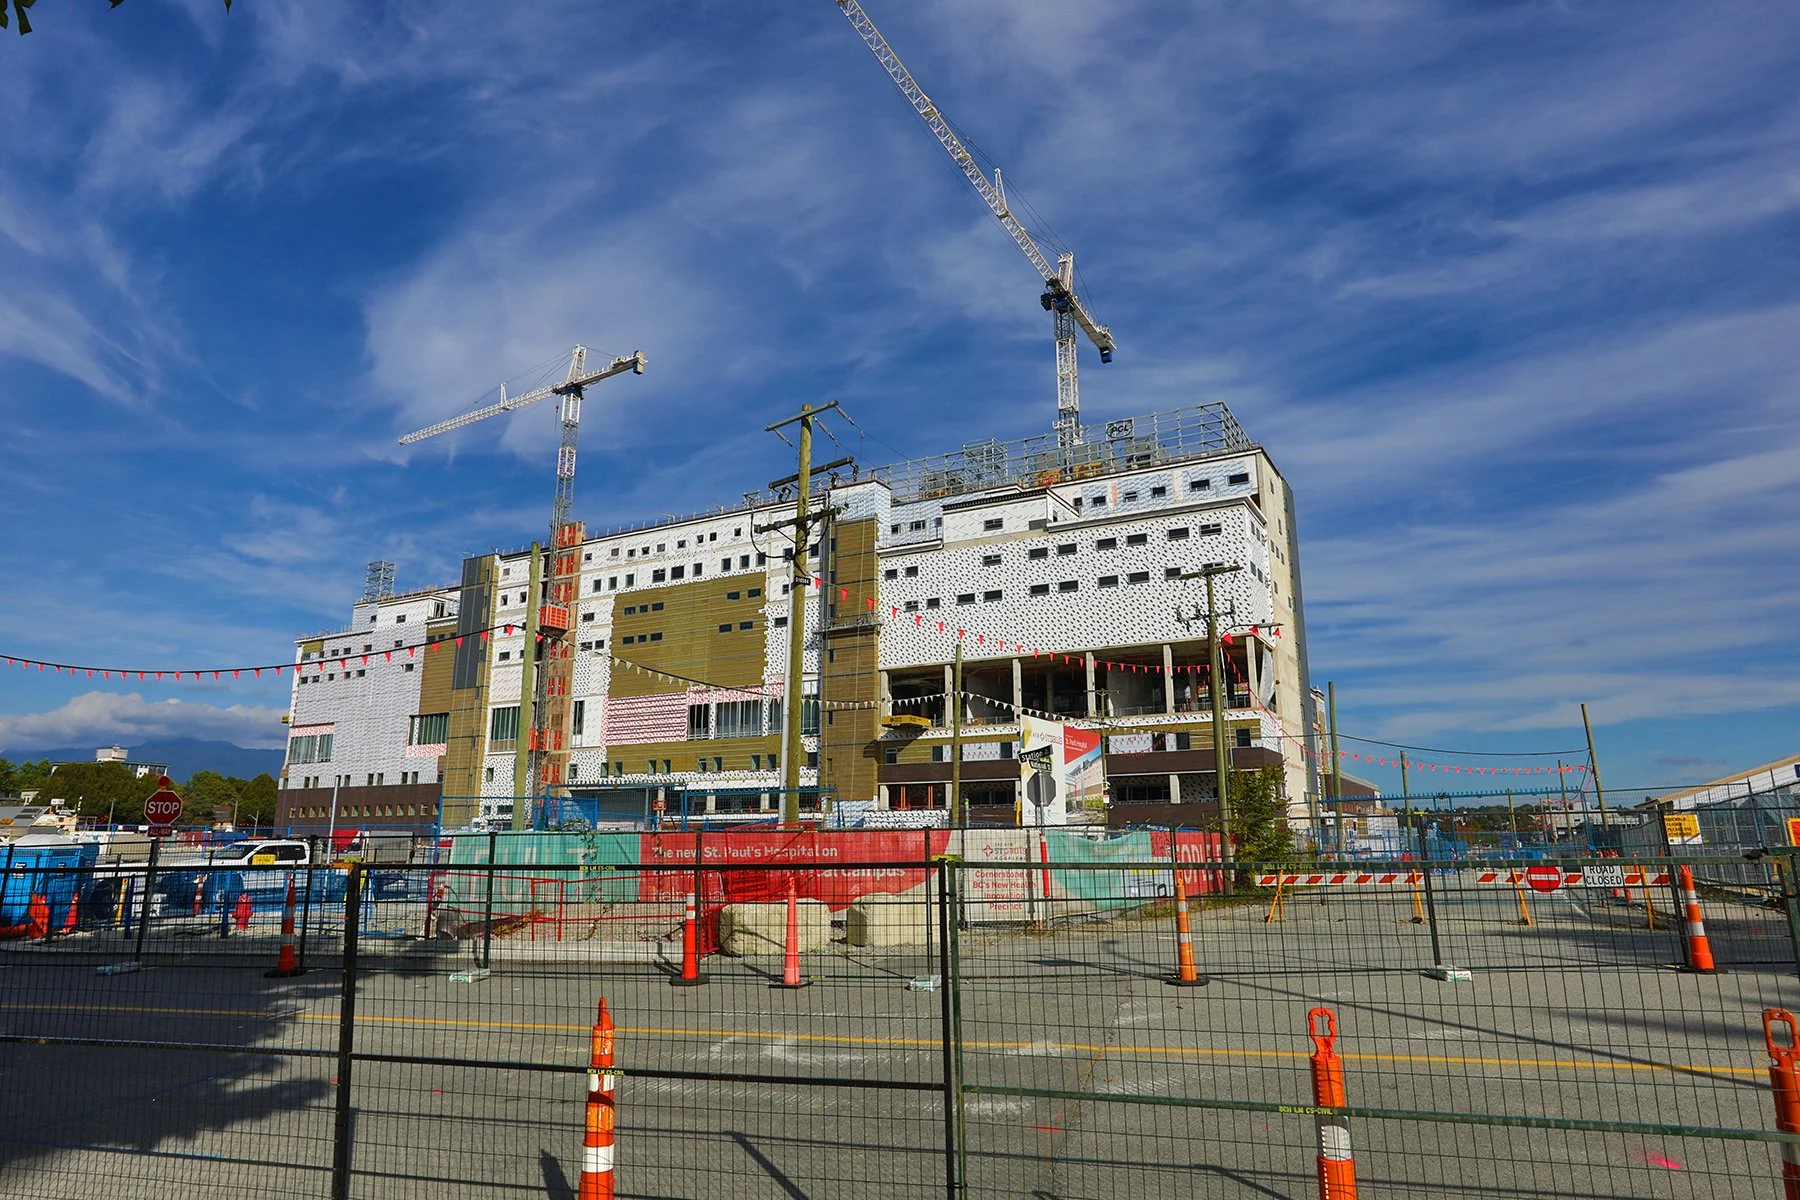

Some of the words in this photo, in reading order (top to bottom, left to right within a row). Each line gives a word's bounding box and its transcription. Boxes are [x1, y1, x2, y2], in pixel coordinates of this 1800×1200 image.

[1110, 425, 1129, 435] PCL
[1021, 751, 1044, 763] Station
[147, 801, 180, 814] STOP
[652, 847, 673, 858] The
[703, 847, 721, 858] St.
[725, 846, 761, 858] Paul's
[764, 846, 819, 860] Hospital
[822, 847, 838, 857] on
[975, 870, 1024, 878] Cornerstone
[1590, 865, 1615, 874] ROAD
[1586, 876, 1622, 885] CLOSED
